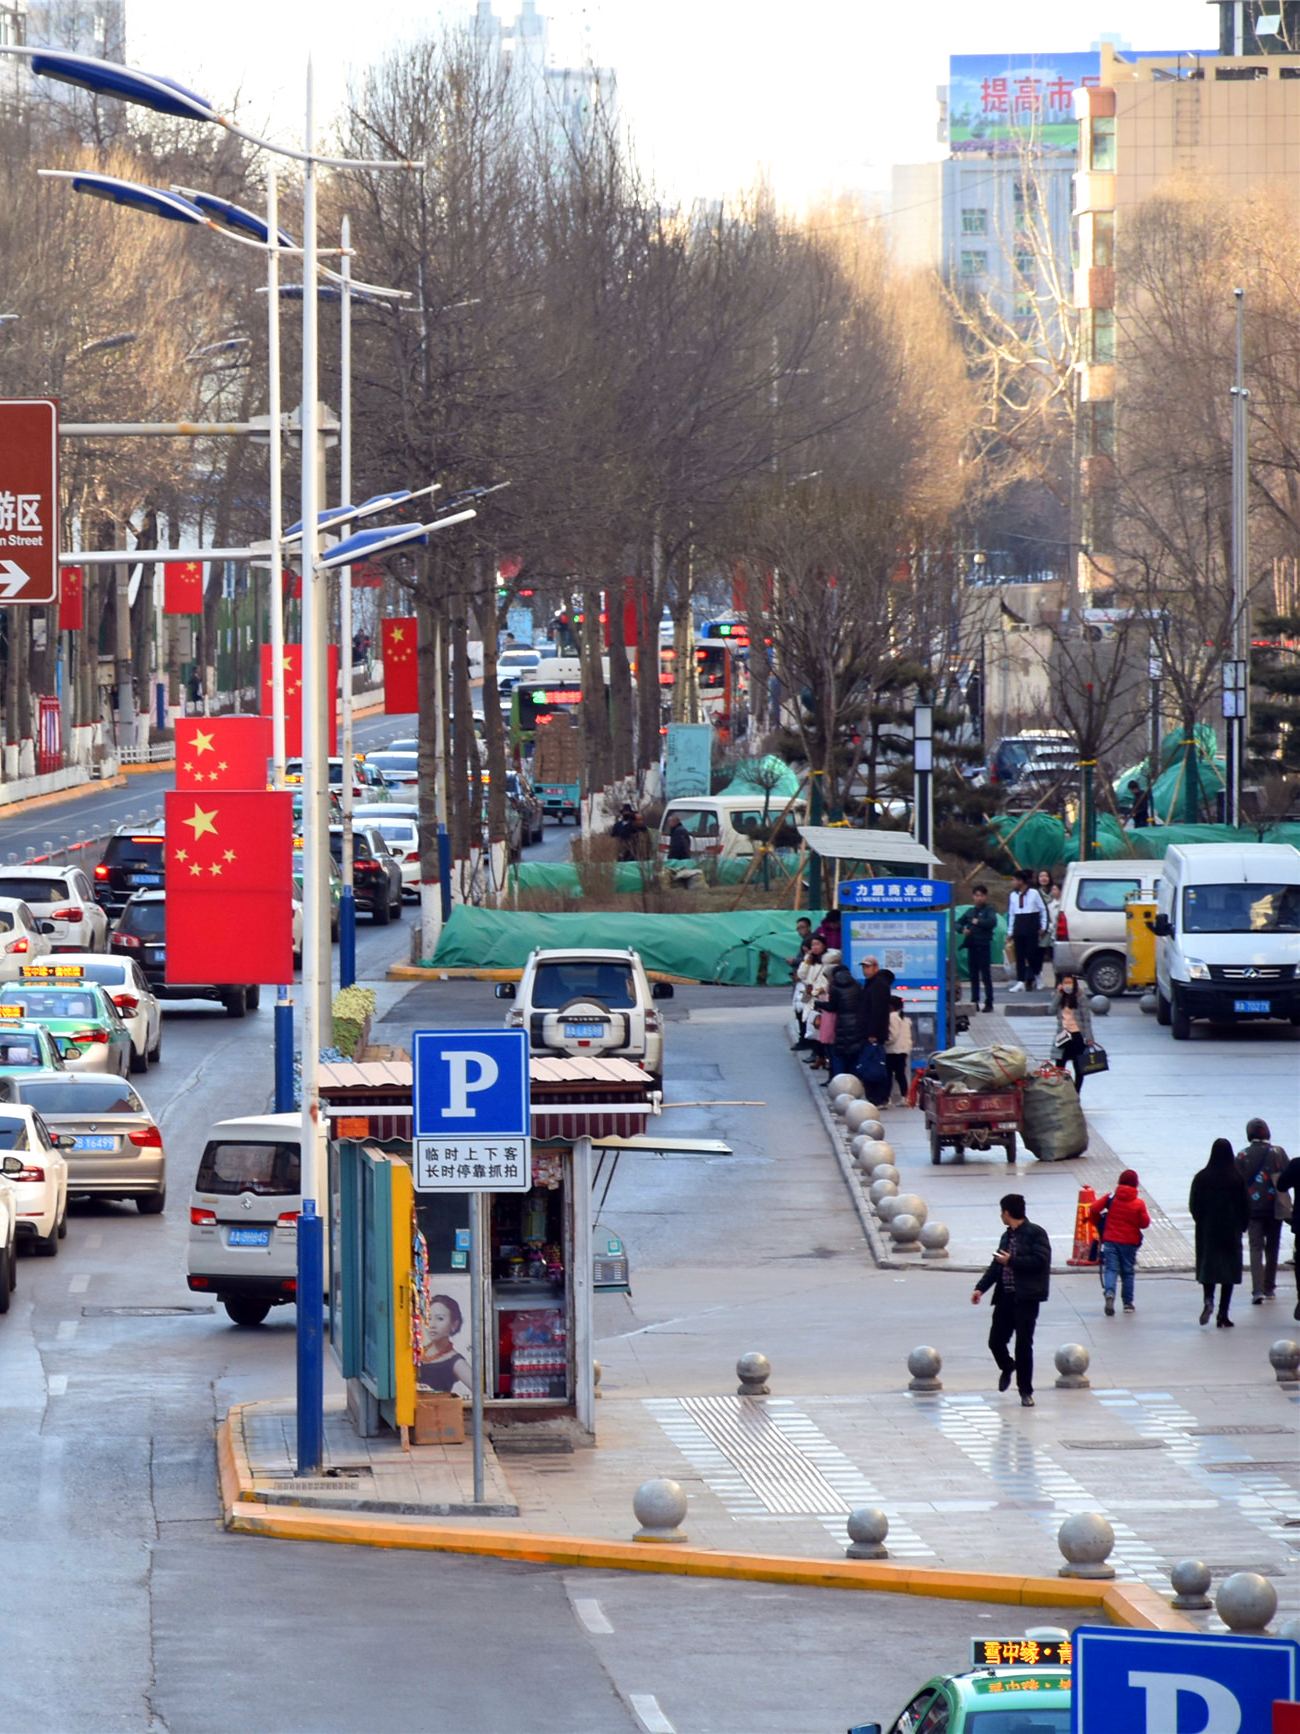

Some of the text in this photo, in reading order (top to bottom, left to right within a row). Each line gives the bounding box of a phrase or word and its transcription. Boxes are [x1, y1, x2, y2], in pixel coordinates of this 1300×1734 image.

[8, 534, 43, 547] Street
[856, 884, 934, 897] 力盟商业巷
[440, 1050, 499, 1118] P
[425, 1147, 518, 1162] 临时上下客
[425, 1163, 518, 1179] 长时停靠抓拍
